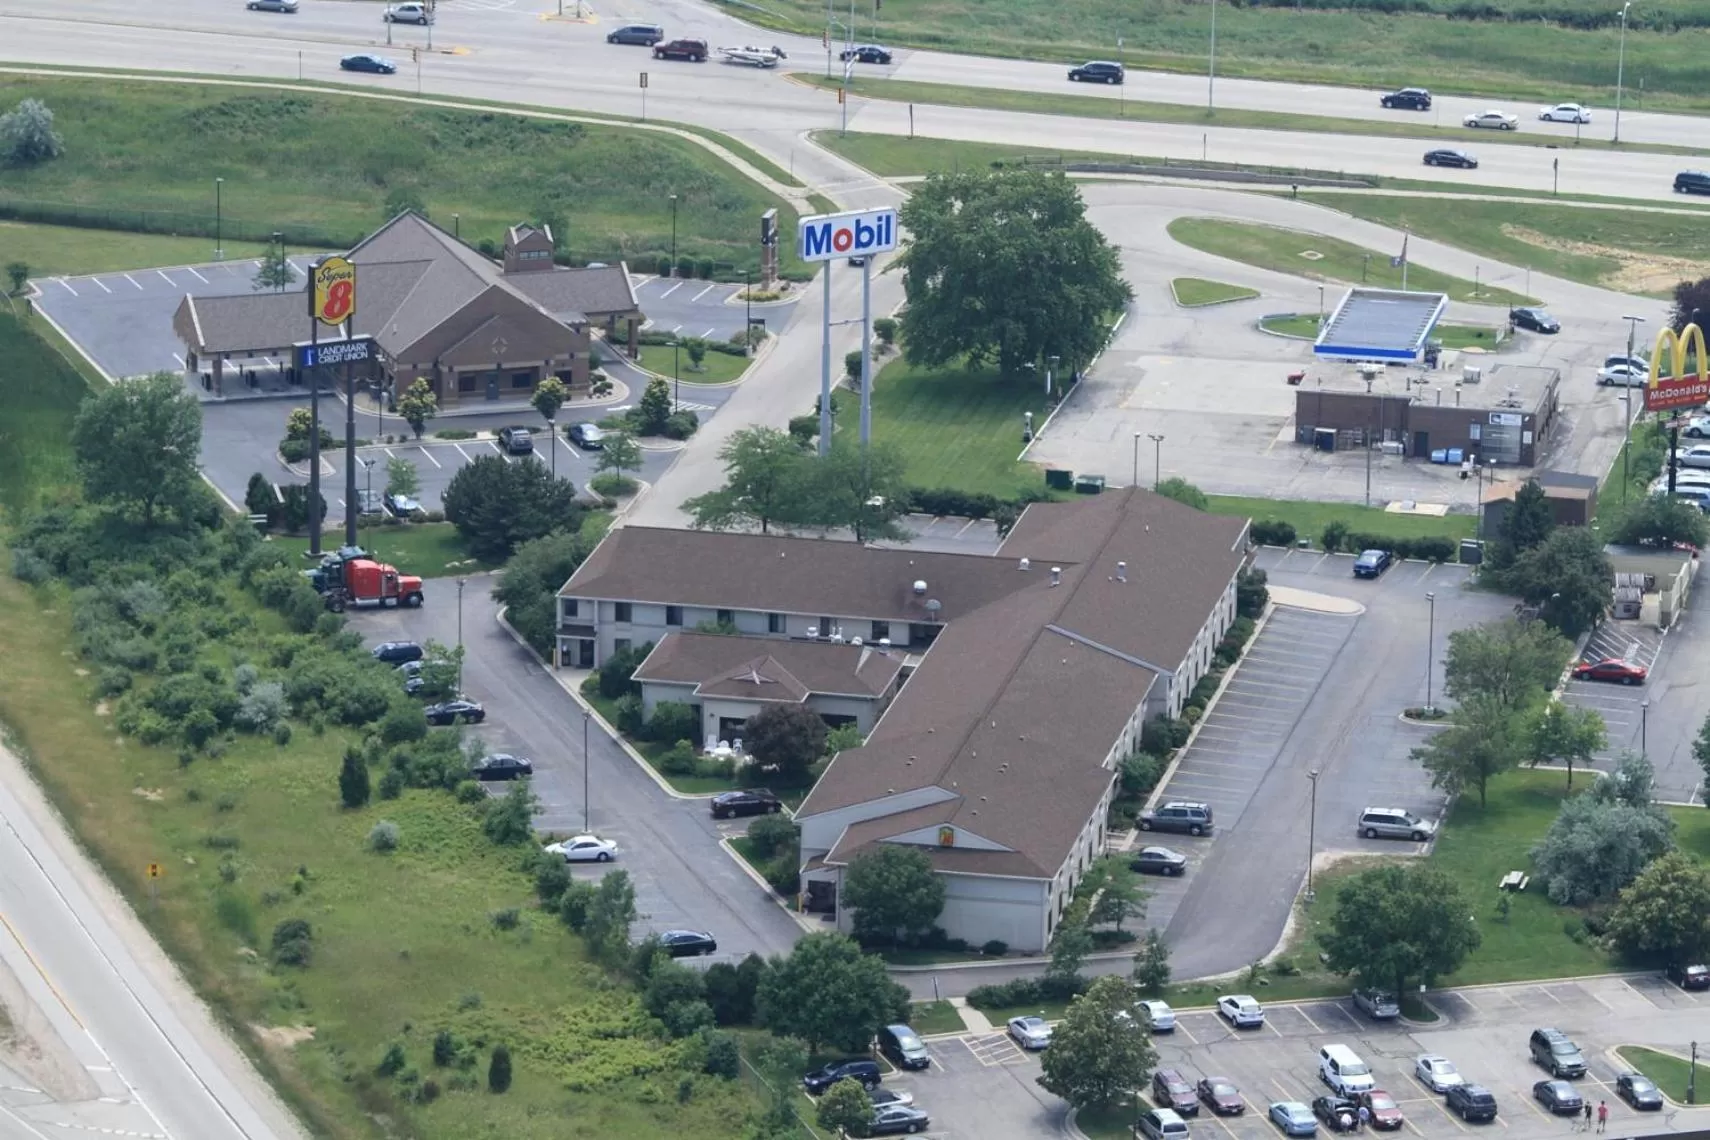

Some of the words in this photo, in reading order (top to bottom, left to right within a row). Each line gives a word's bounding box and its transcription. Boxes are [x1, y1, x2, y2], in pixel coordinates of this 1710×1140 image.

[805, 214, 892, 257] Mobil
[322, 280, 353, 320] 8
[318, 342, 369, 356] LANDMARK
[318, 353, 342, 364] CREDIT
[343, 350, 369, 361] UNION
[1650, 384, 1707, 400] McDonald's
